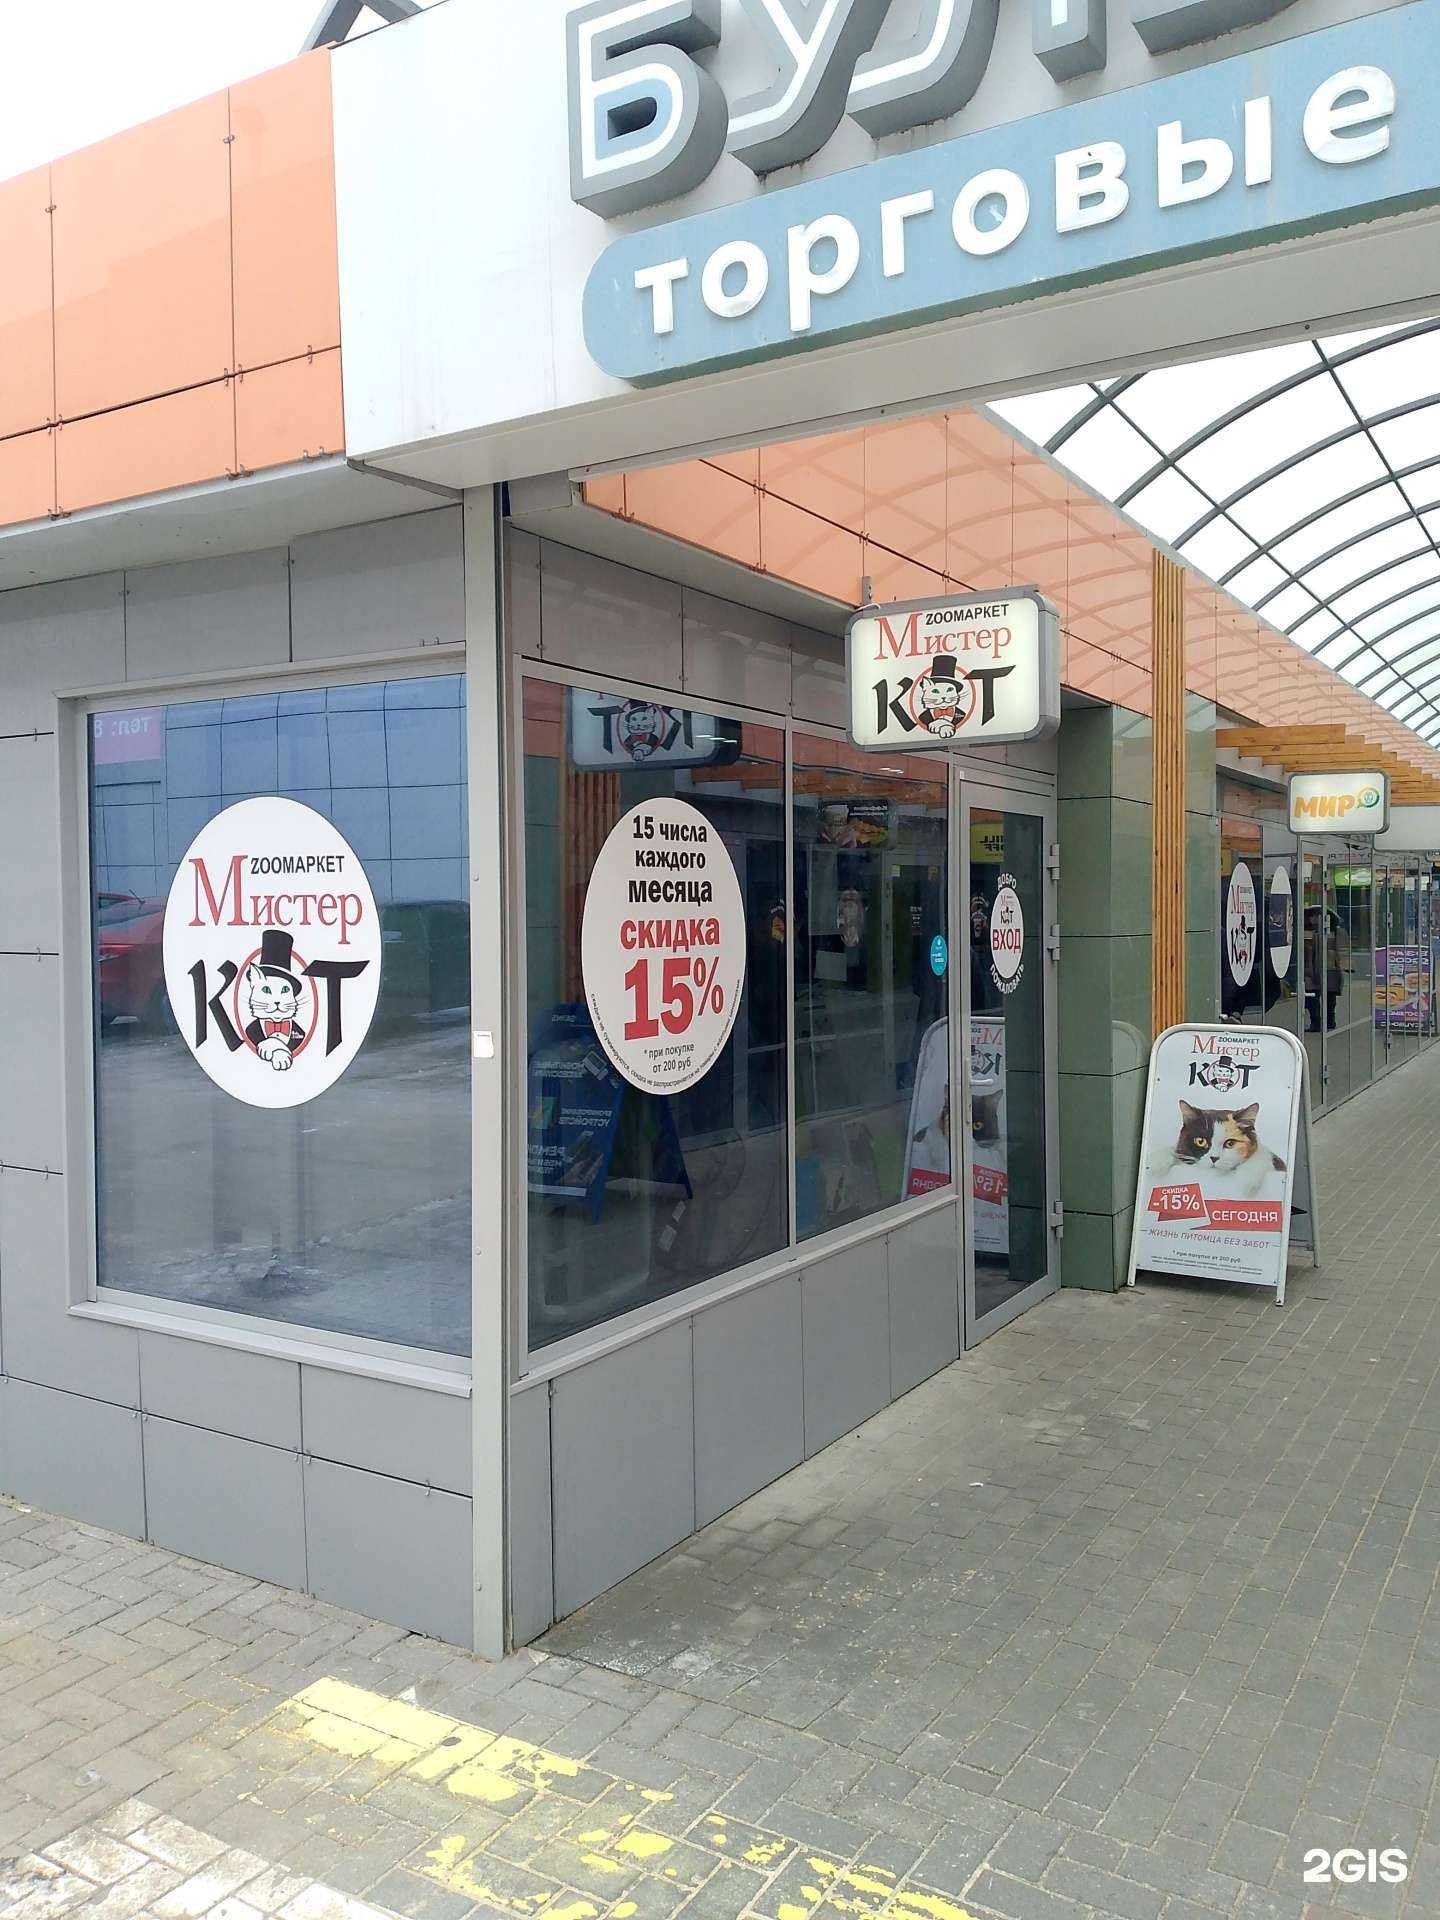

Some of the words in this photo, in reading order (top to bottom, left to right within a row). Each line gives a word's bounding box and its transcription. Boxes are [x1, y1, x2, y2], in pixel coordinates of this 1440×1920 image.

[633, 65, 1396, 333] торговые
[873, 612, 1012, 660] Мистер
[633, 814, 655, 840] 15
[659, 822, 708, 843] числа
[635, 849, 706, 872] каждого
[628, 879, 713, 908] месяца
[997, 872, 1017, 891] ДОБРО
[188, 854, 363, 945] Мистер
[620, 917, 720, 953] скидка
[992, 927, 1022, 954] ВХОД
[989, 962, 1025, 995] ПОЖАЛОВАТЬ
[623, 956, 725, 1042] 15%
[665, 1043, 695, 1056] покупке
[1190, 1034, 1260, 1062] Мистер
[652, 1064, 662, 1074] от
[663, 1058, 676, 1072] 200
[677, 1056, 692, 1071] руб
[1153, 1193, 1200, 1211] -15%
[1161, 1186, 1189, 1195] СКИДКА
[1211, 1210, 1278, 1223] СЕГОДНЯ
[1149, 1228, 1179, 1239] ЖИЗНЬ
[1181, 1232, 1222, 1245] ПИТОМЦА
[1223, 1237, 1241, 1247] БЕЗ
[1241, 1239, 1271, 1249] ЗАБОТ
